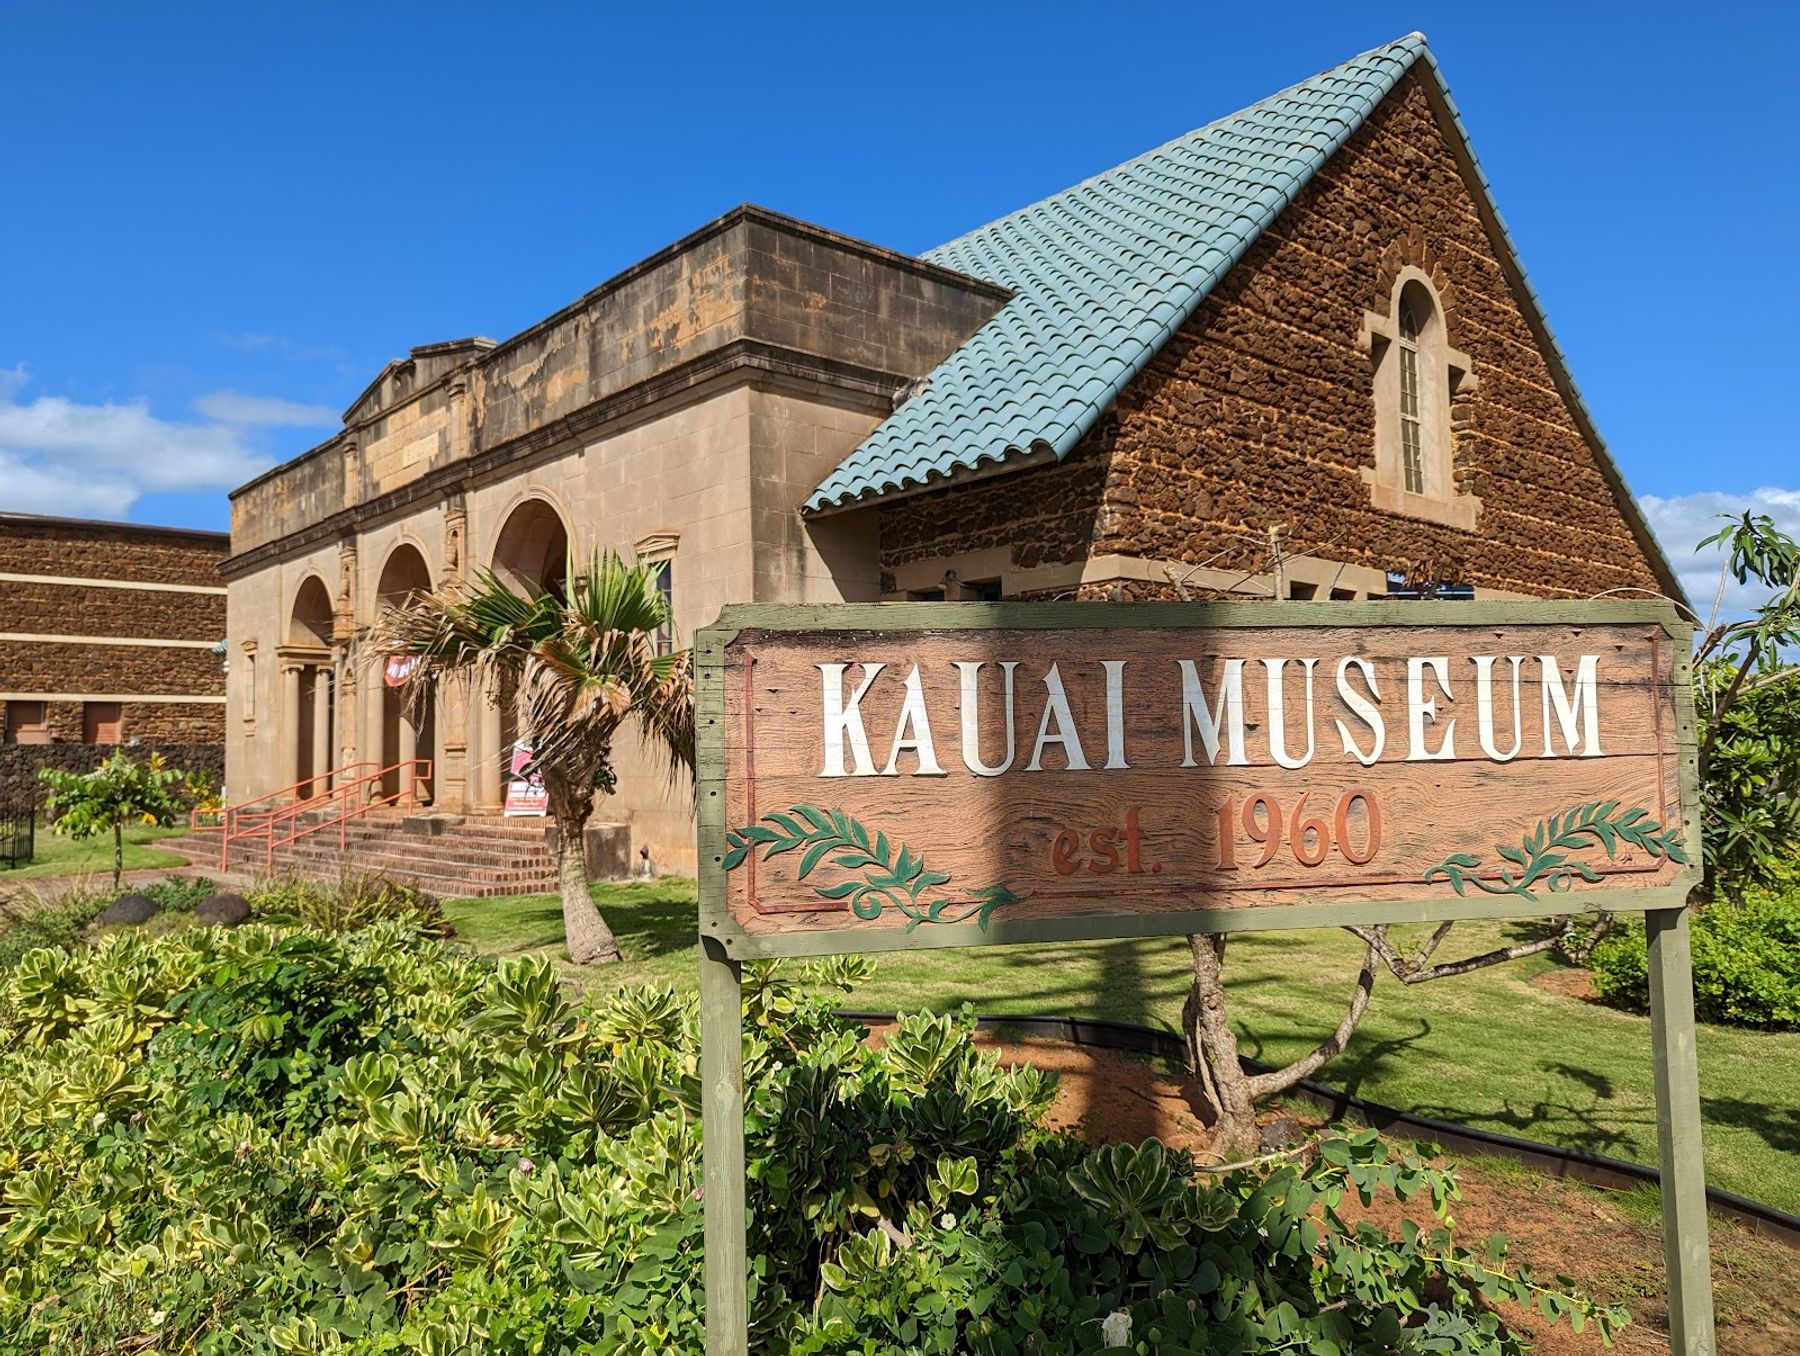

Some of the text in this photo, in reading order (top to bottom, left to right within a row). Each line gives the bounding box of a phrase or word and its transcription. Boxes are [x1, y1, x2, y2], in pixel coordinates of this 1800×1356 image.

[816, 655, 1605, 776] KAUAI MUSEUM
[1053, 789, 1380, 874] est. 1960
